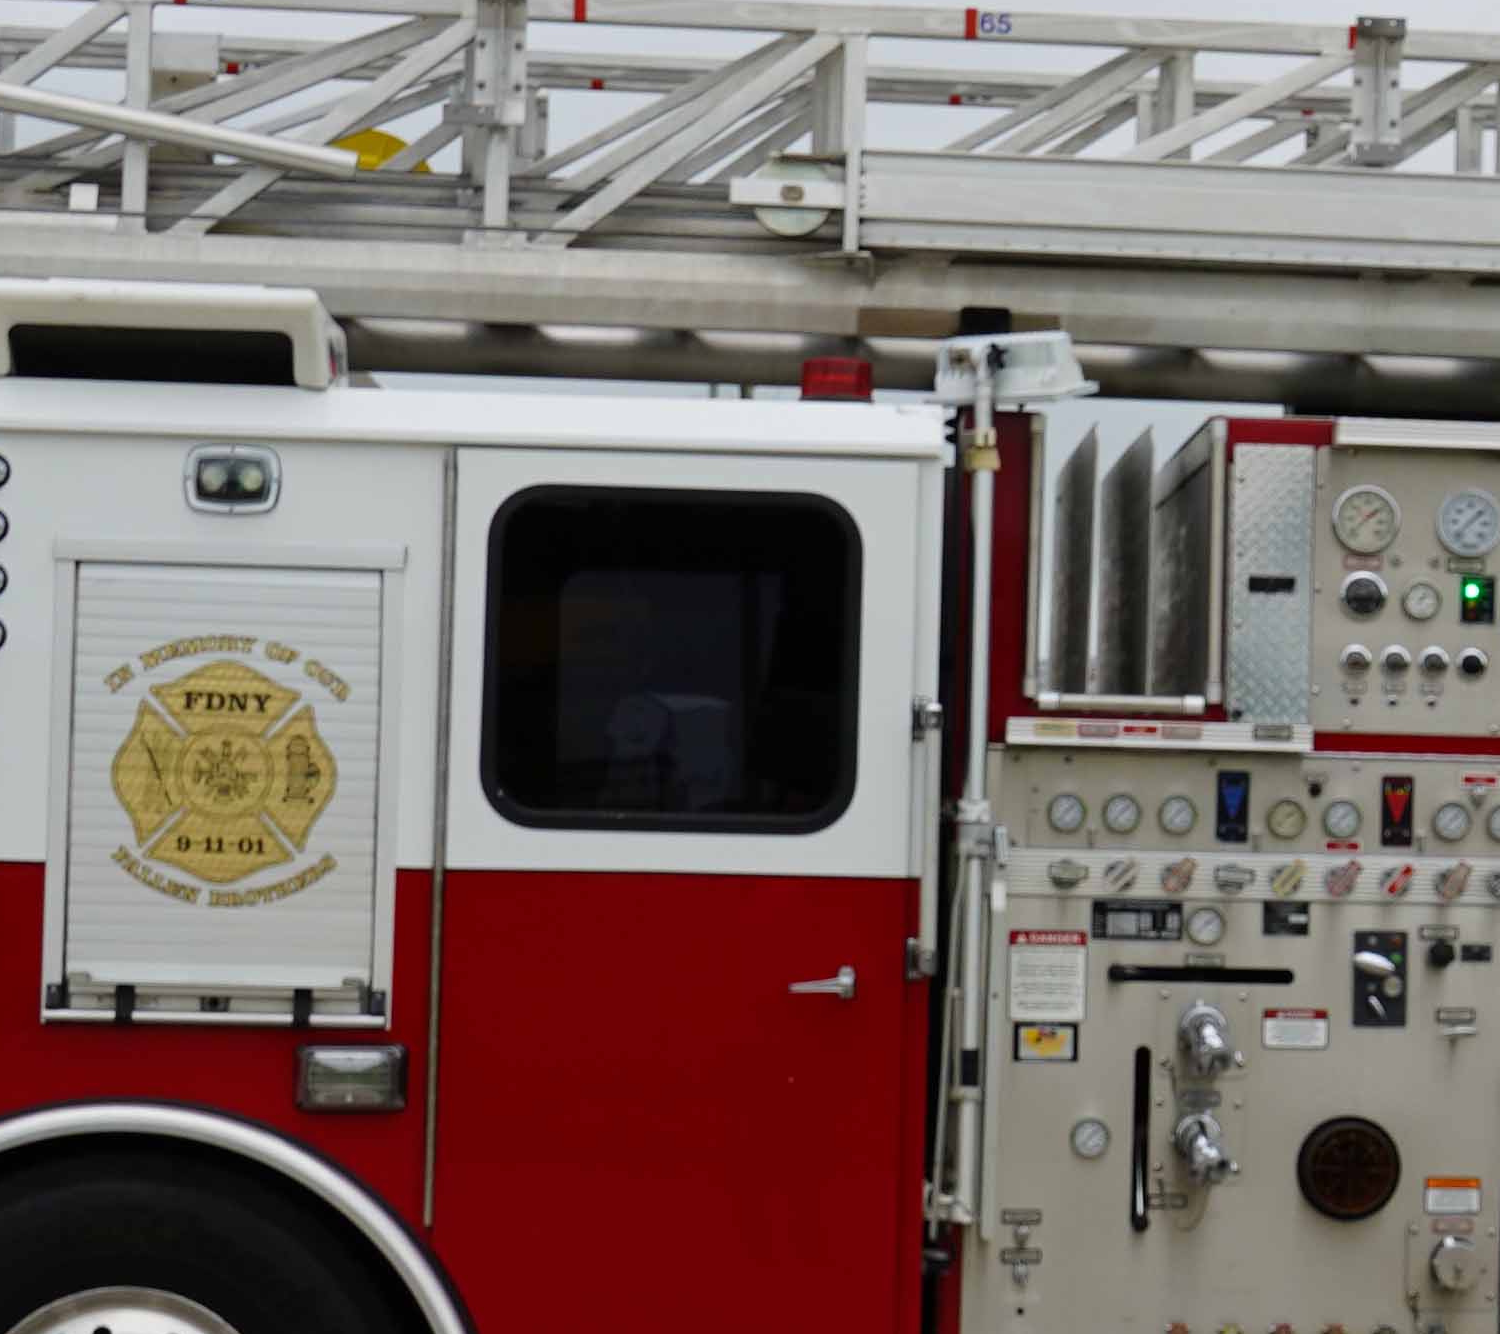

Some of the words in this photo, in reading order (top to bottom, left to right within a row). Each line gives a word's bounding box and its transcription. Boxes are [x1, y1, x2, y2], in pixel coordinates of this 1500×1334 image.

[979, 12, 1013, 34] 65
[104, 663, 135, 694] IN
[139, 634, 258, 670] MEMORY
[265, 641, 300, 665] OF
[304, 659, 350, 702] OUR
[182, 691, 273, 713] FDNY
[176, 836, 266, 855] 9-11-01
